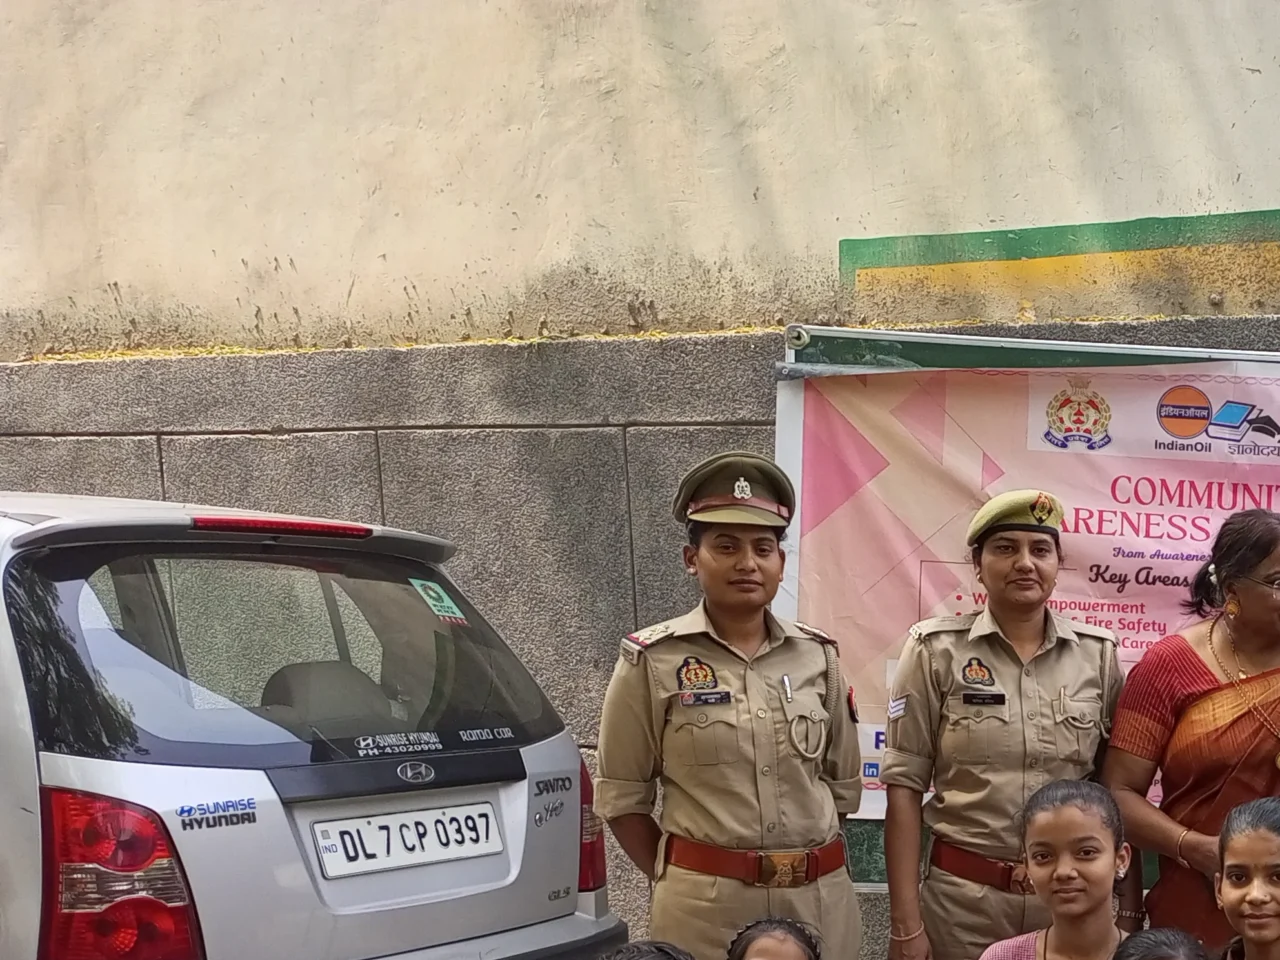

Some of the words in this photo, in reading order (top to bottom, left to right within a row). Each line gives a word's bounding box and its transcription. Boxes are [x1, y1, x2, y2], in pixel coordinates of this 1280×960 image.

[1154, 440, 1212, 453] IndianOil
[1228, 441, 1280, 457] ज्ञानोदय
[1060, 507, 1211, 542] RENESS
[1112, 546, 1146, 559] From
[1150, 548, 1212, 562] Awarenes
[1088, 564, 1130, 594] Key
[1134, 566, 1191, 588] Areas
[1045, 600, 1146, 614] mpowerment
[1118, 617, 1167, 636] Safety
[376, 732, 409, 747] SUNRISE
[358, 743, 443, 757] PH-43020999
[534, 776, 573, 797] SANTRO
[196, 798, 257, 816] SUNRISE
[181, 812, 257, 831] HYUNDAI
[321, 844, 338, 854] IND
